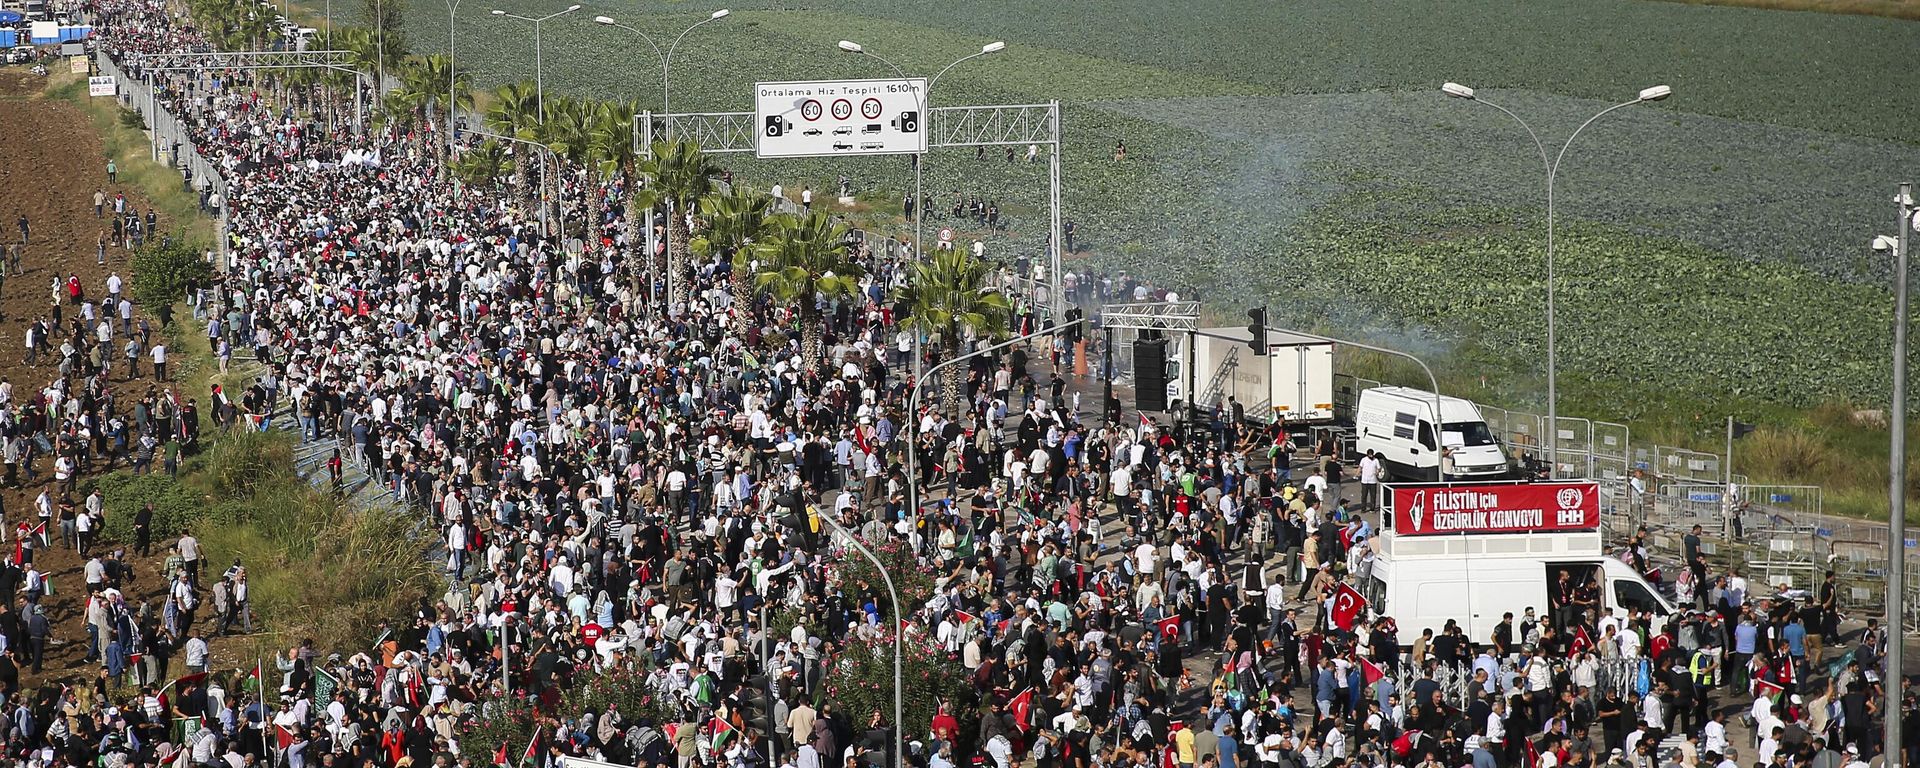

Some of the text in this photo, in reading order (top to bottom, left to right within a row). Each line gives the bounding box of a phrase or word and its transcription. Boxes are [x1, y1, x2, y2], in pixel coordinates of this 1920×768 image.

[761, 84, 920, 97] Ortalama Hız Tespiti 1610m
[805, 103, 879, 116] 60 60 50
[942, 231, 950, 239] 60
[1433, 489, 1478, 510] FİLİSTİN
[1433, 509, 1543, 530] ÖZGÜRLÜK KONVOYU
